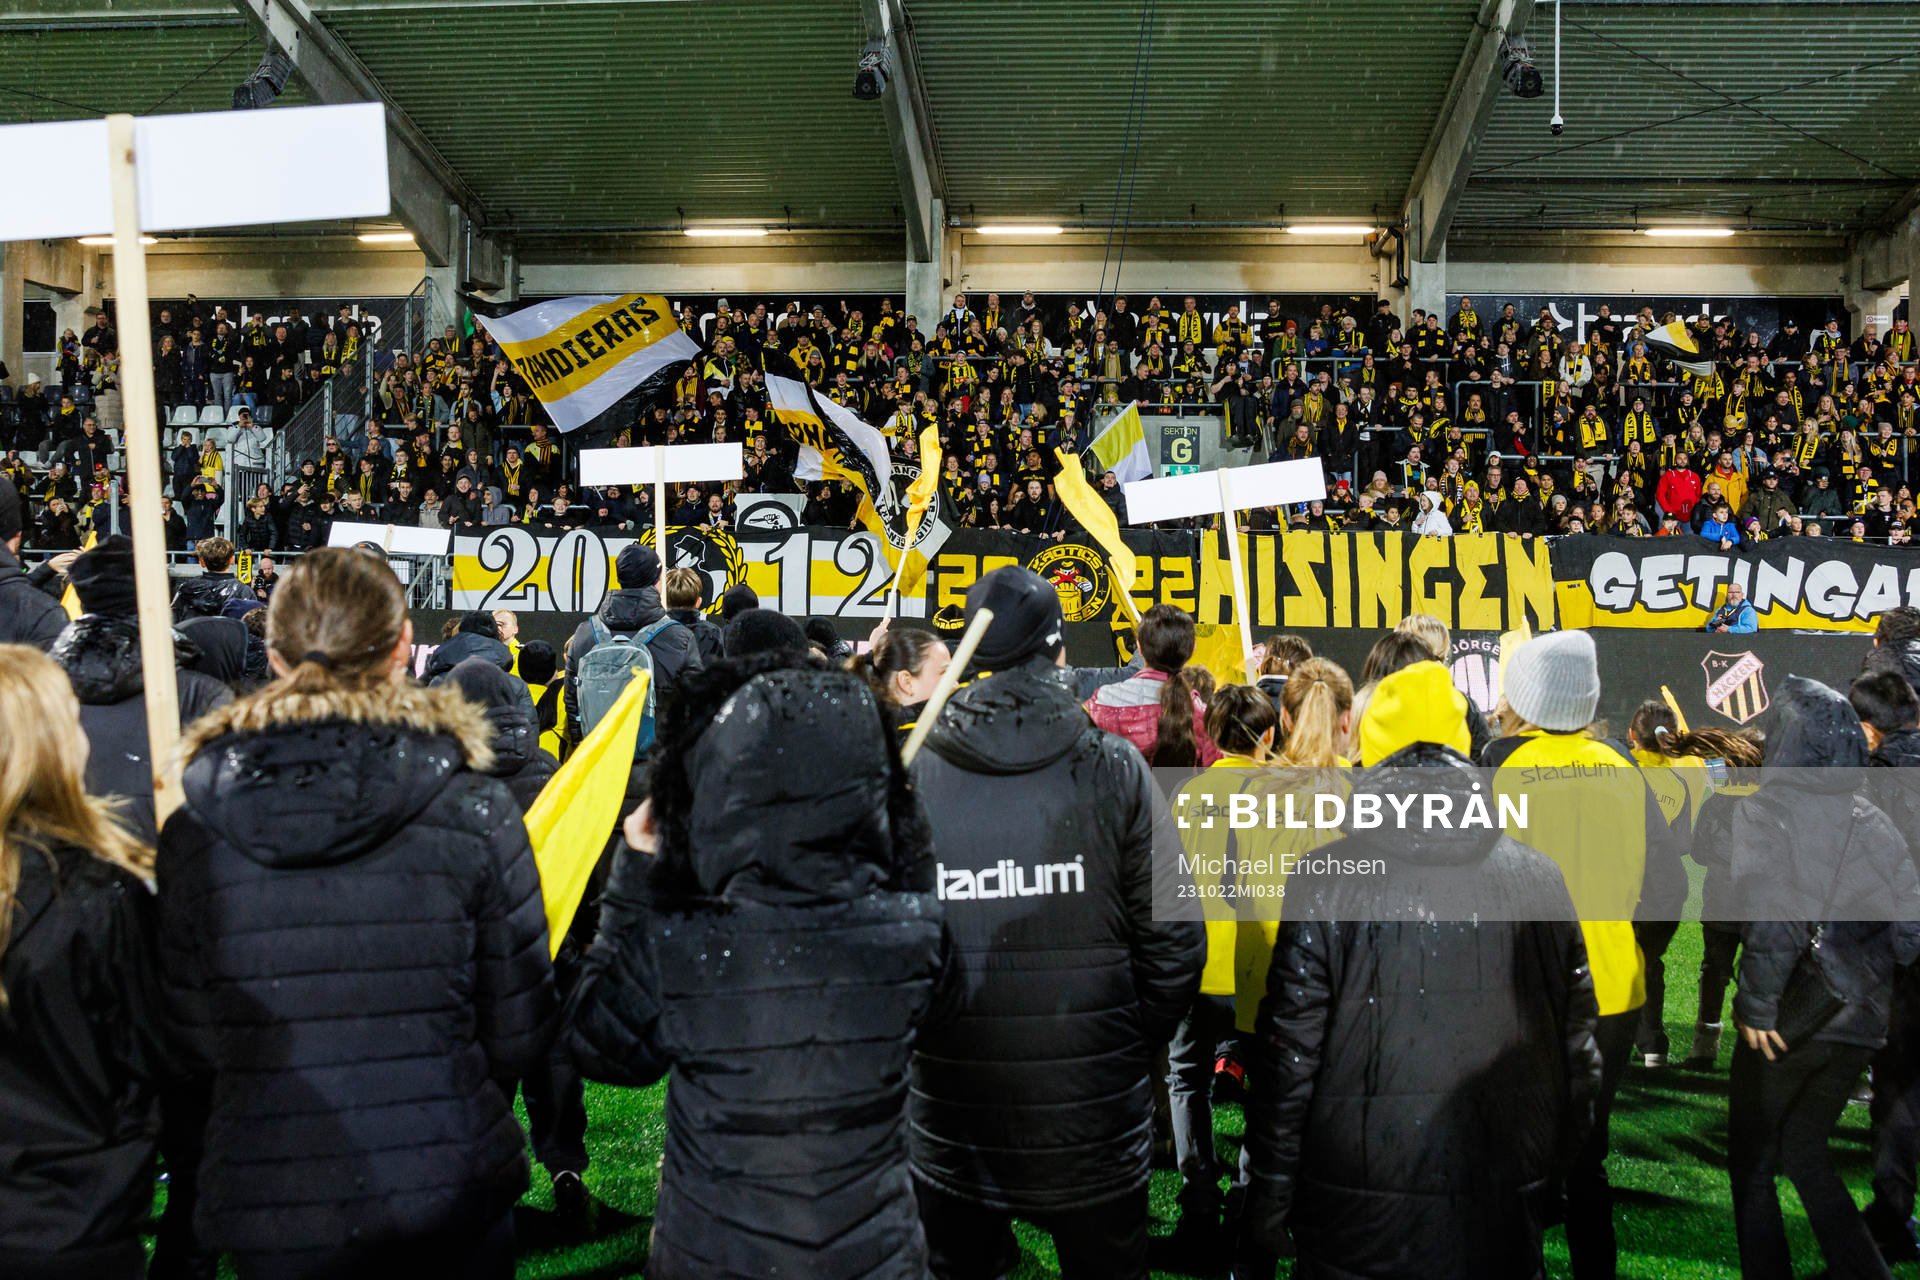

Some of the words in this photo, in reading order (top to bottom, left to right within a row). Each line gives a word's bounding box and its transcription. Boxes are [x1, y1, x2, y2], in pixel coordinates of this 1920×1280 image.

[1171, 438, 1192, 463] G
[478, 527, 609, 612] 20
[765, 529, 901, 618] 12
[1199, 530, 1554, 631] HISINGEN
[1452, 639, 1500, 654] JÖRGE
[1520, 759, 1618, 786] stadium
[936, 854, 1085, 900] tadium
